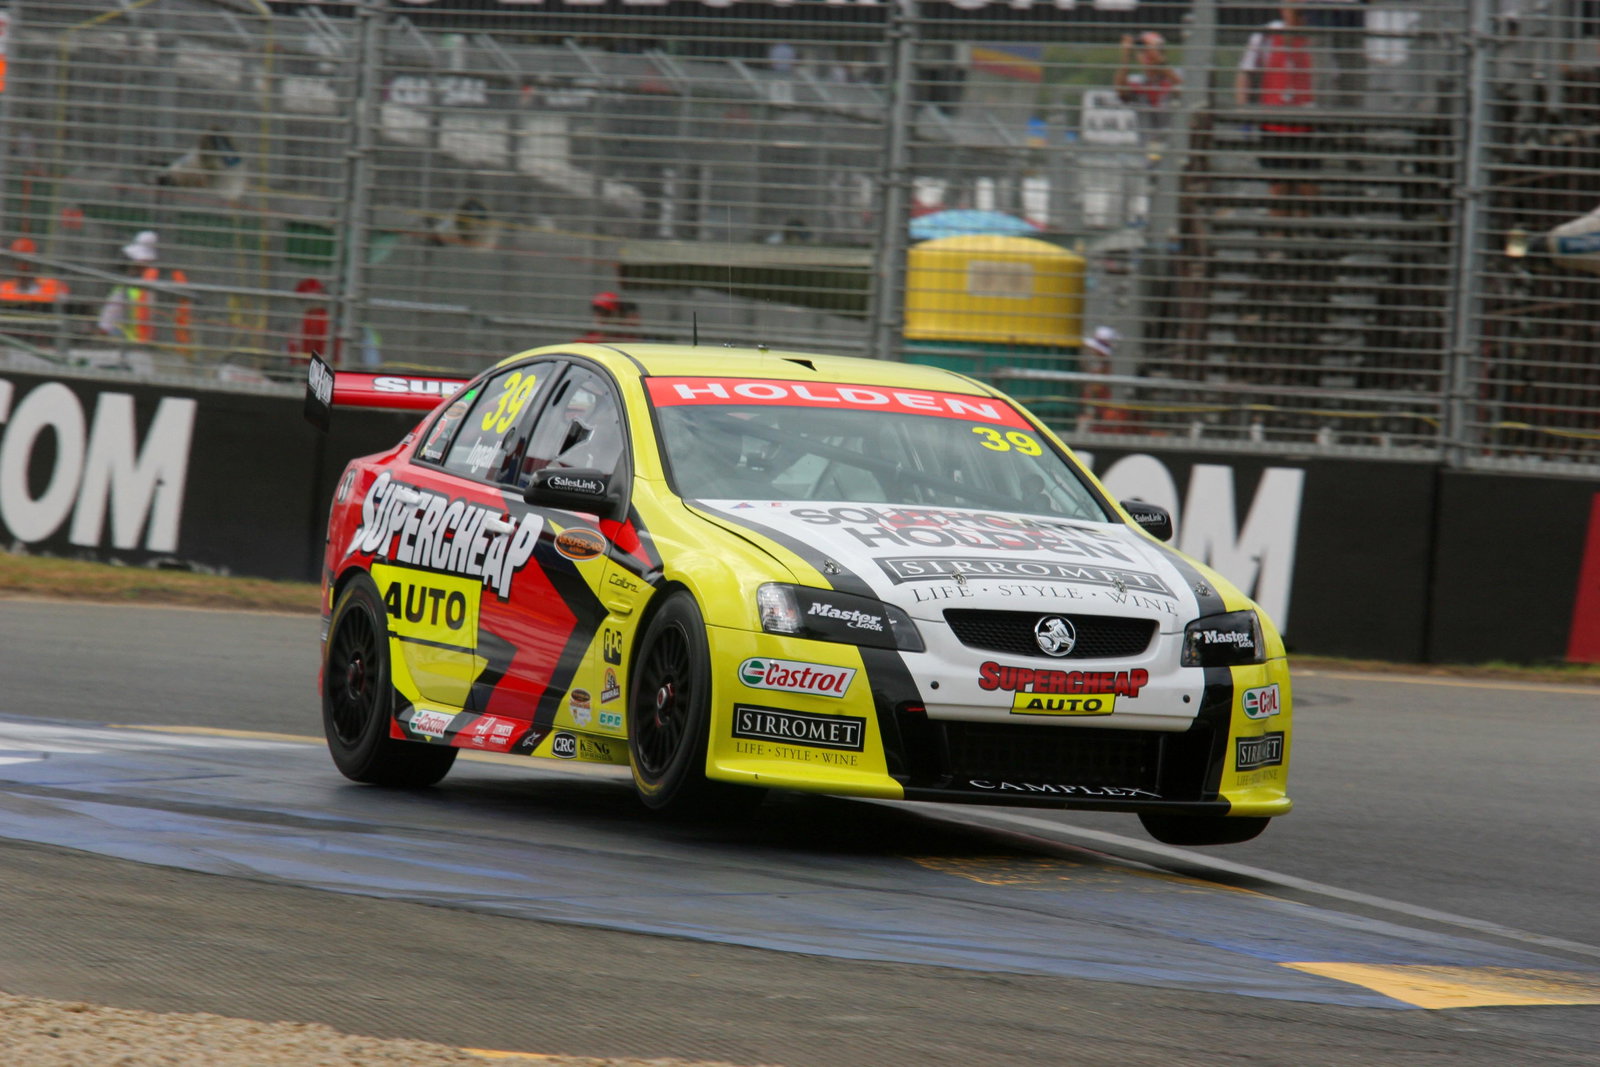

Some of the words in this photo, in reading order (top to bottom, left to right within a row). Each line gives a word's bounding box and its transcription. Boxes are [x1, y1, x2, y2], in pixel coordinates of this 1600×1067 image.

[481, 371, 536, 434] 39
[673, 383, 1001, 420] HOLDEN
[972, 426, 1042, 457] 39
[553, 476, 597, 490] SalesLink
[346, 470, 544, 599] SUPERCHEAP
[843, 527, 1136, 564] HOLDEN
[902, 560, 1148, 587] SIRROMET
[384, 581, 467, 631] AUTO
[807, 602, 882, 625] Master
[912, 585, 975, 602] LIFE
[998, 585, 1083, 600] STYLE
[1105, 591, 1179, 617] WINE
[847, 620, 883, 632] Lock
[1202, 629, 1249, 645] Master
[1238, 639, 1254, 649] Lock
[765, 662, 848, 694] Castrol
[978, 661, 1149, 698] SUPERCHEAP
[1025, 698, 1103, 712] AUTO
[742, 713, 857, 743] SIRROMET
[554, 737, 575, 752] CRC
[736, 742, 764, 755] LIFE
[774, 747, 811, 761] STYLE
[822, 752, 858, 766] WINE
[968, 779, 1163, 798] CAMPLEX
